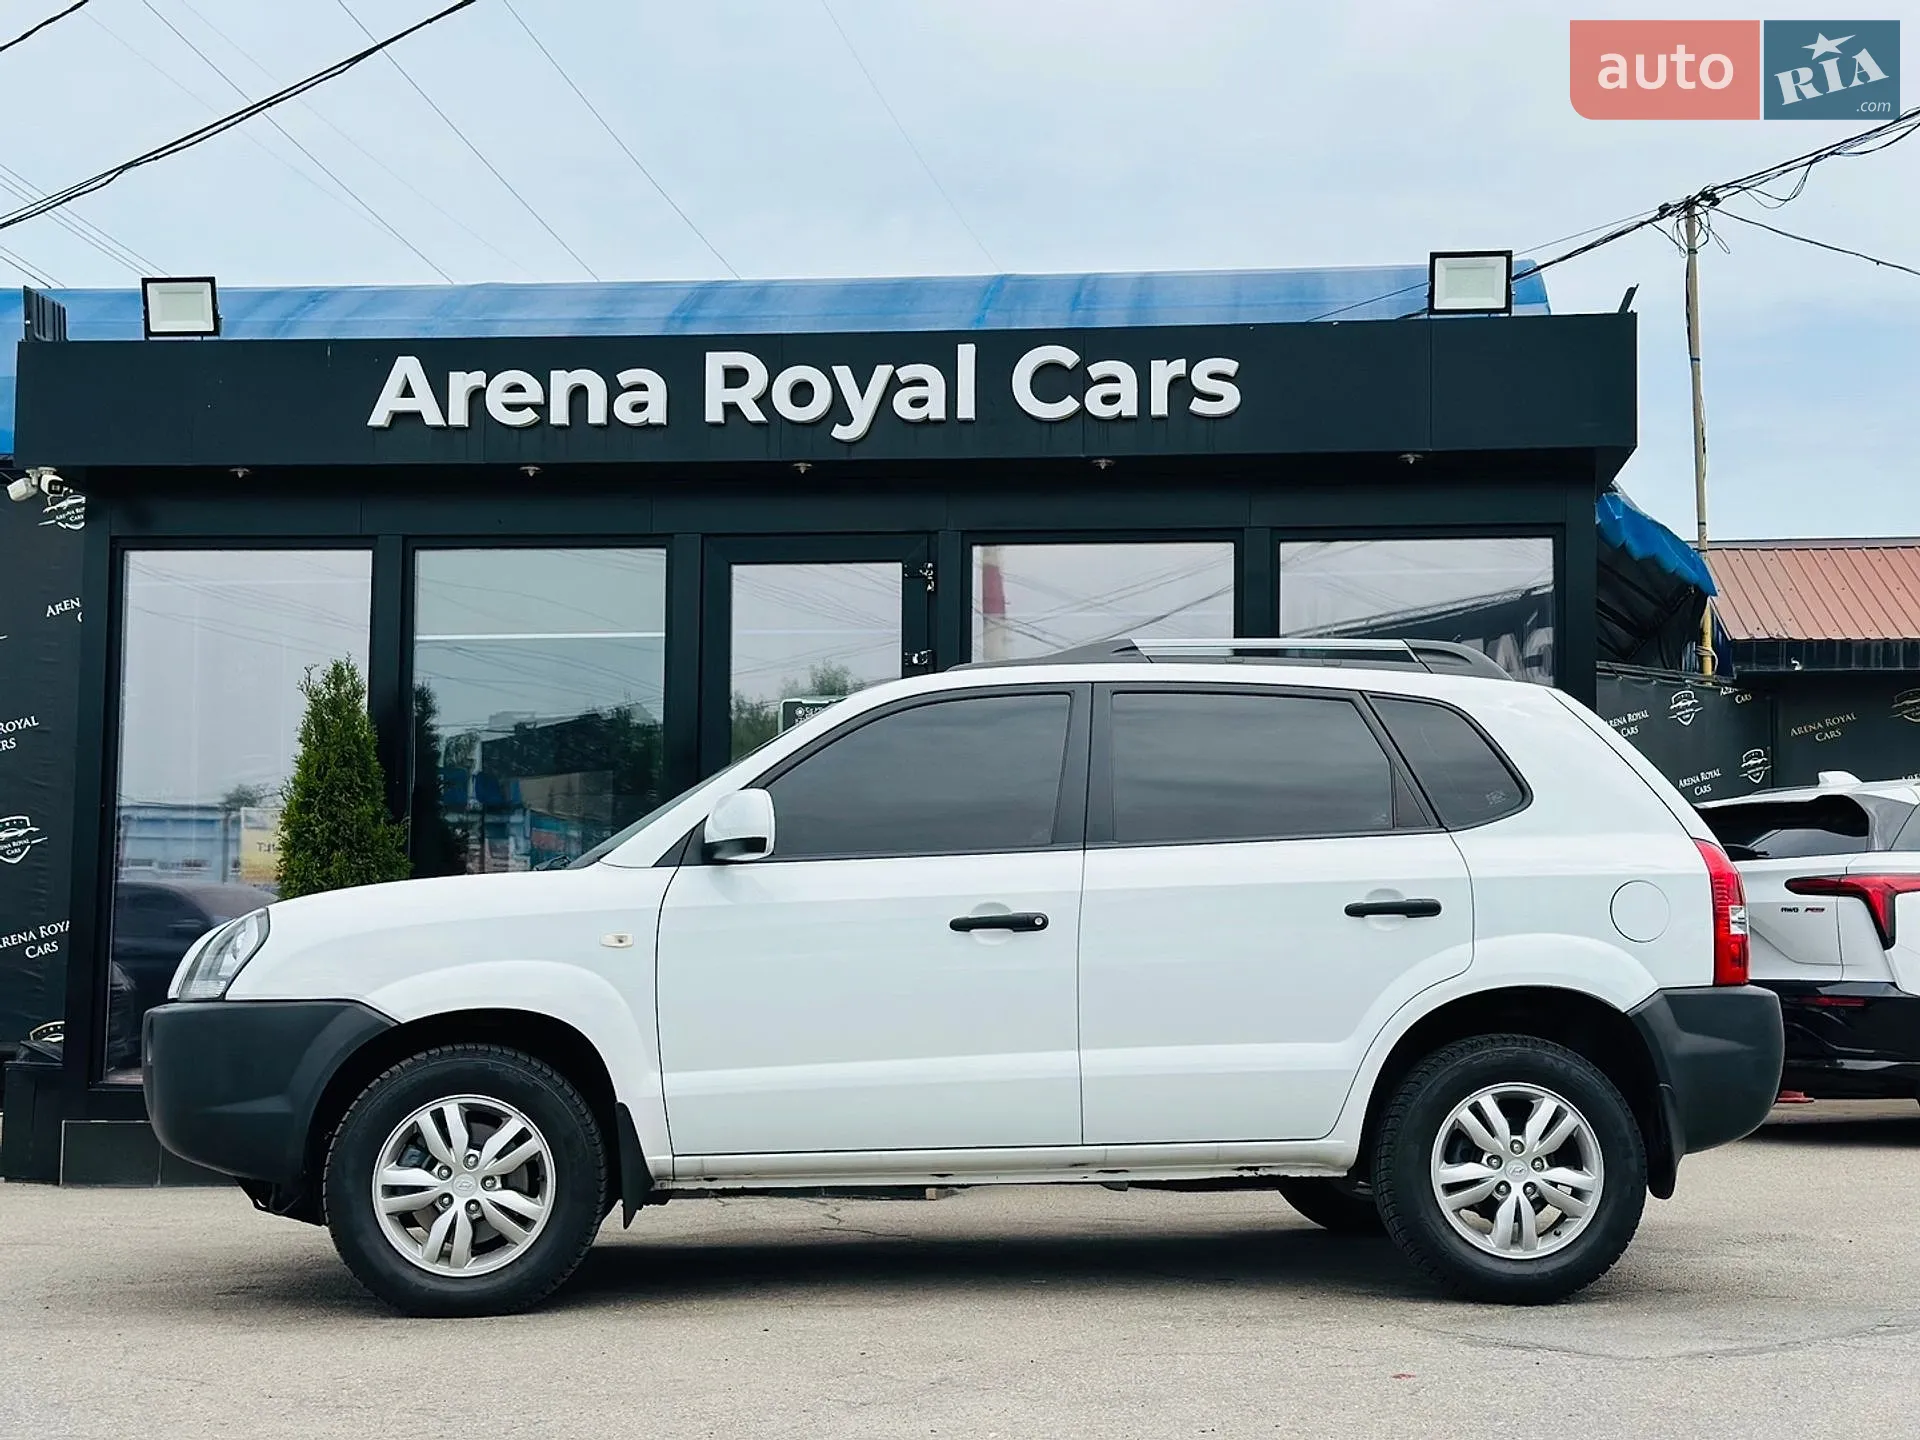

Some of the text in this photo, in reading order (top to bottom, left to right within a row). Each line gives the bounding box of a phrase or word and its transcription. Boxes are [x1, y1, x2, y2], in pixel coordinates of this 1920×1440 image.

[367, 343, 1241, 441] Arena Royal Cars
[0, 715, 40, 735] ROYAL
[1627, 709, 1649, 723] ROYAL
[1790, 712, 1858, 737] ARENA ROYAL
[1621, 725, 1639, 737] CARS
[1815, 728, 1842, 742] CARS
[0, 737, 17, 752] RS
[1678, 768, 1722, 789] ARENA ROYAL
[1694, 783, 1712, 796] CARS
[0, 930, 37, 949] RENA
[25, 940, 59, 959] CARS
